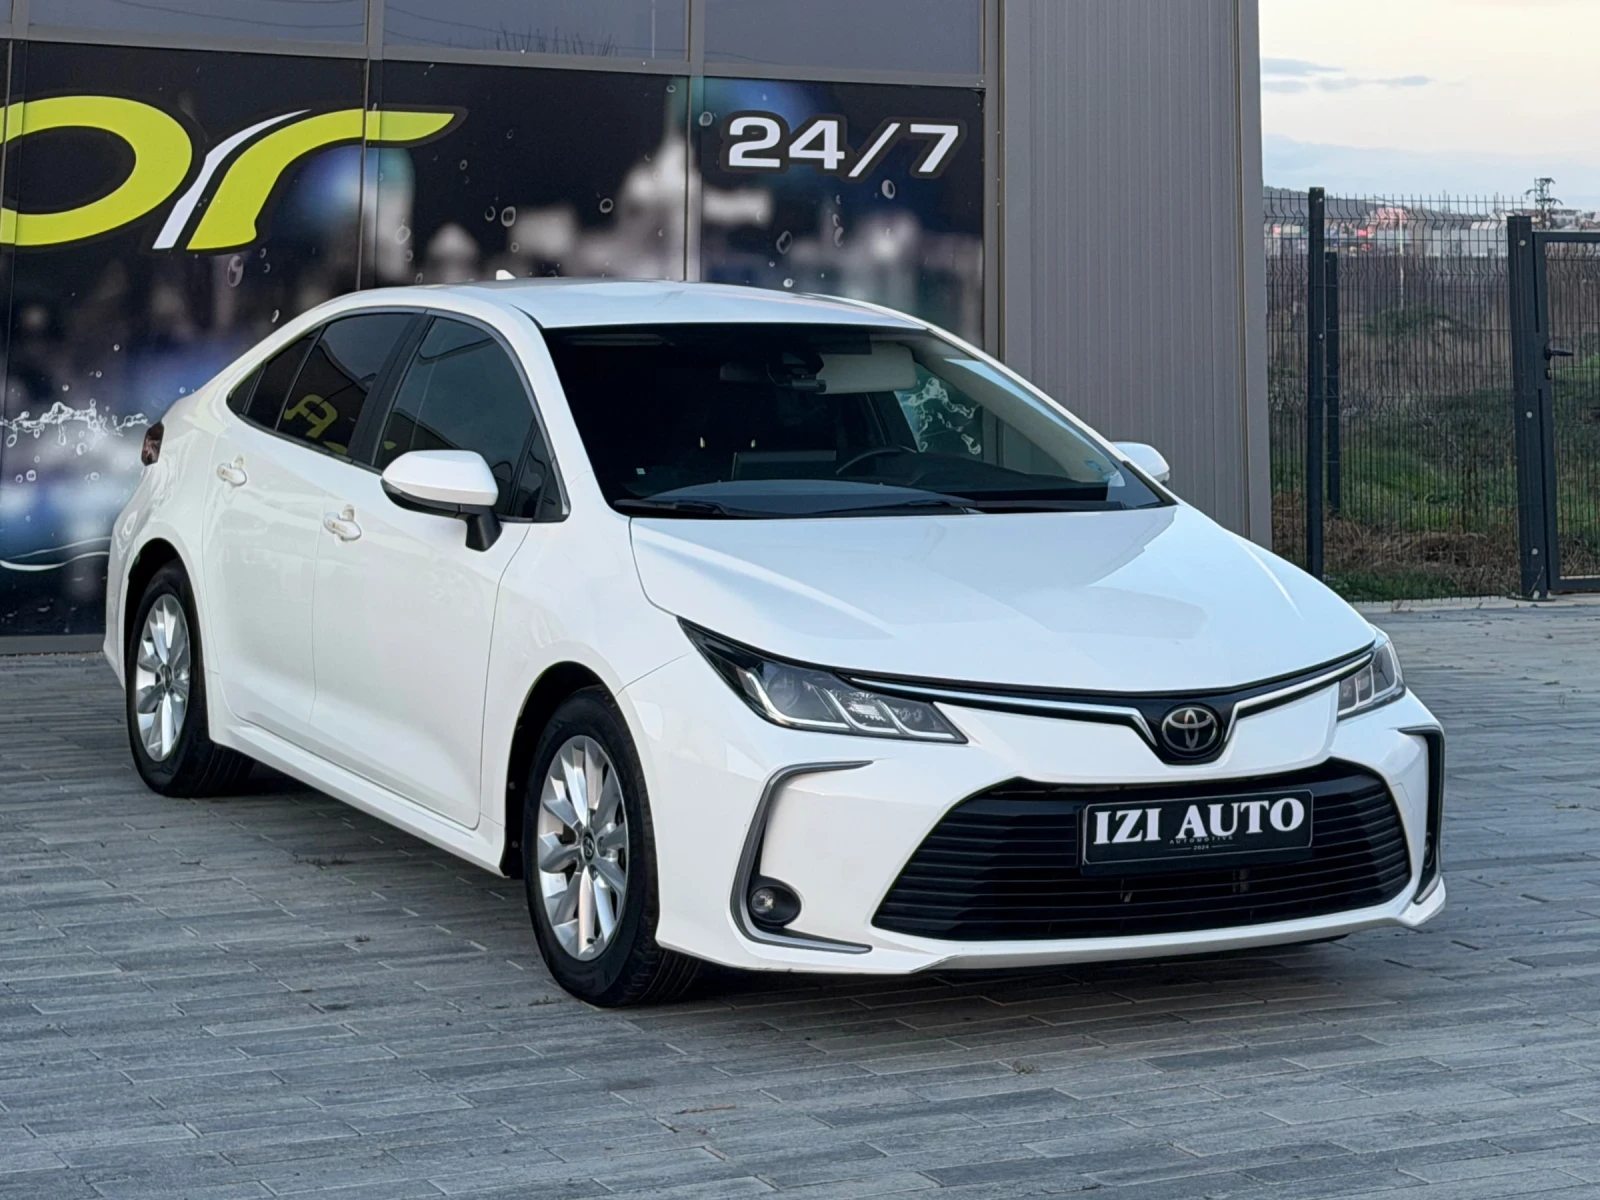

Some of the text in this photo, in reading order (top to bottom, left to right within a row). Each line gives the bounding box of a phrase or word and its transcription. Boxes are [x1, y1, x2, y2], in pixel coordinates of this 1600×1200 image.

[728, 116, 959, 178] 24/7
[1093, 797, 1305, 845] IZI AUTO
[1169, 835, 1233, 845] AUTOMOTIVE
